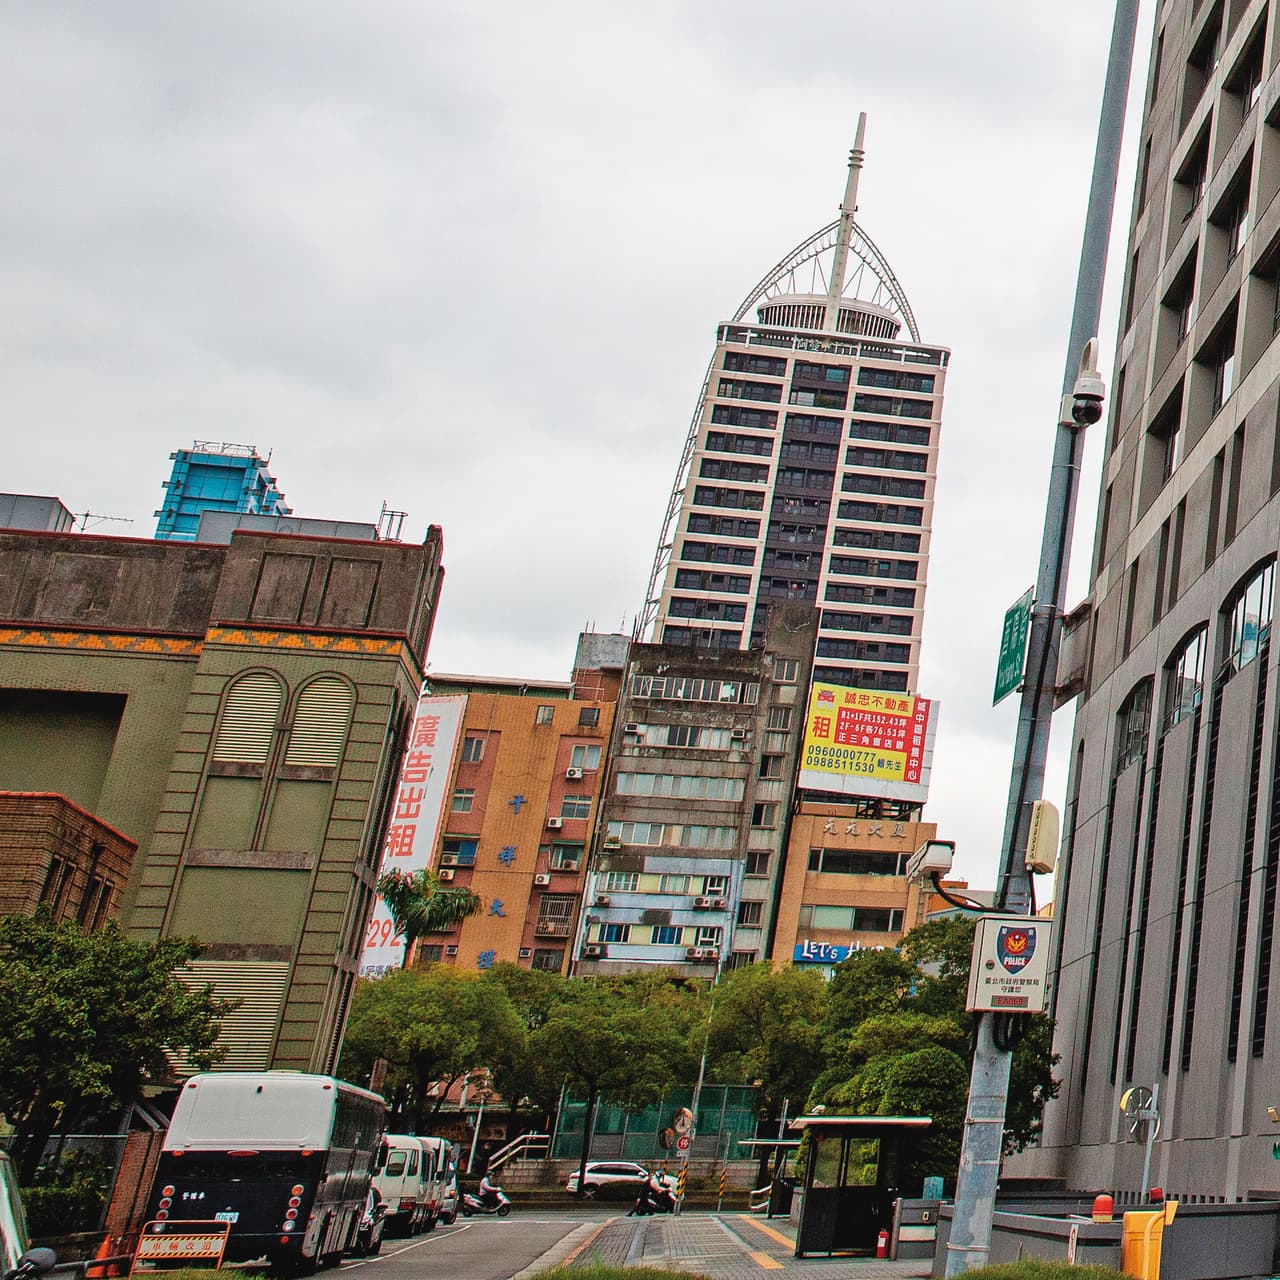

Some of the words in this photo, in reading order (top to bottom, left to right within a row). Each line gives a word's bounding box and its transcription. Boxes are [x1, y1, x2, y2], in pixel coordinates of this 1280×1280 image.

[845, 691, 911, 713] 誠忠不動產
[813, 715, 831, 739] 租
[808, 744, 877, 762] 0960000777
[806, 756, 875, 773] 0988511530
[388, 714, 440, 858] 廣告出租
[1003, 957, 1026, 966] POLICE
